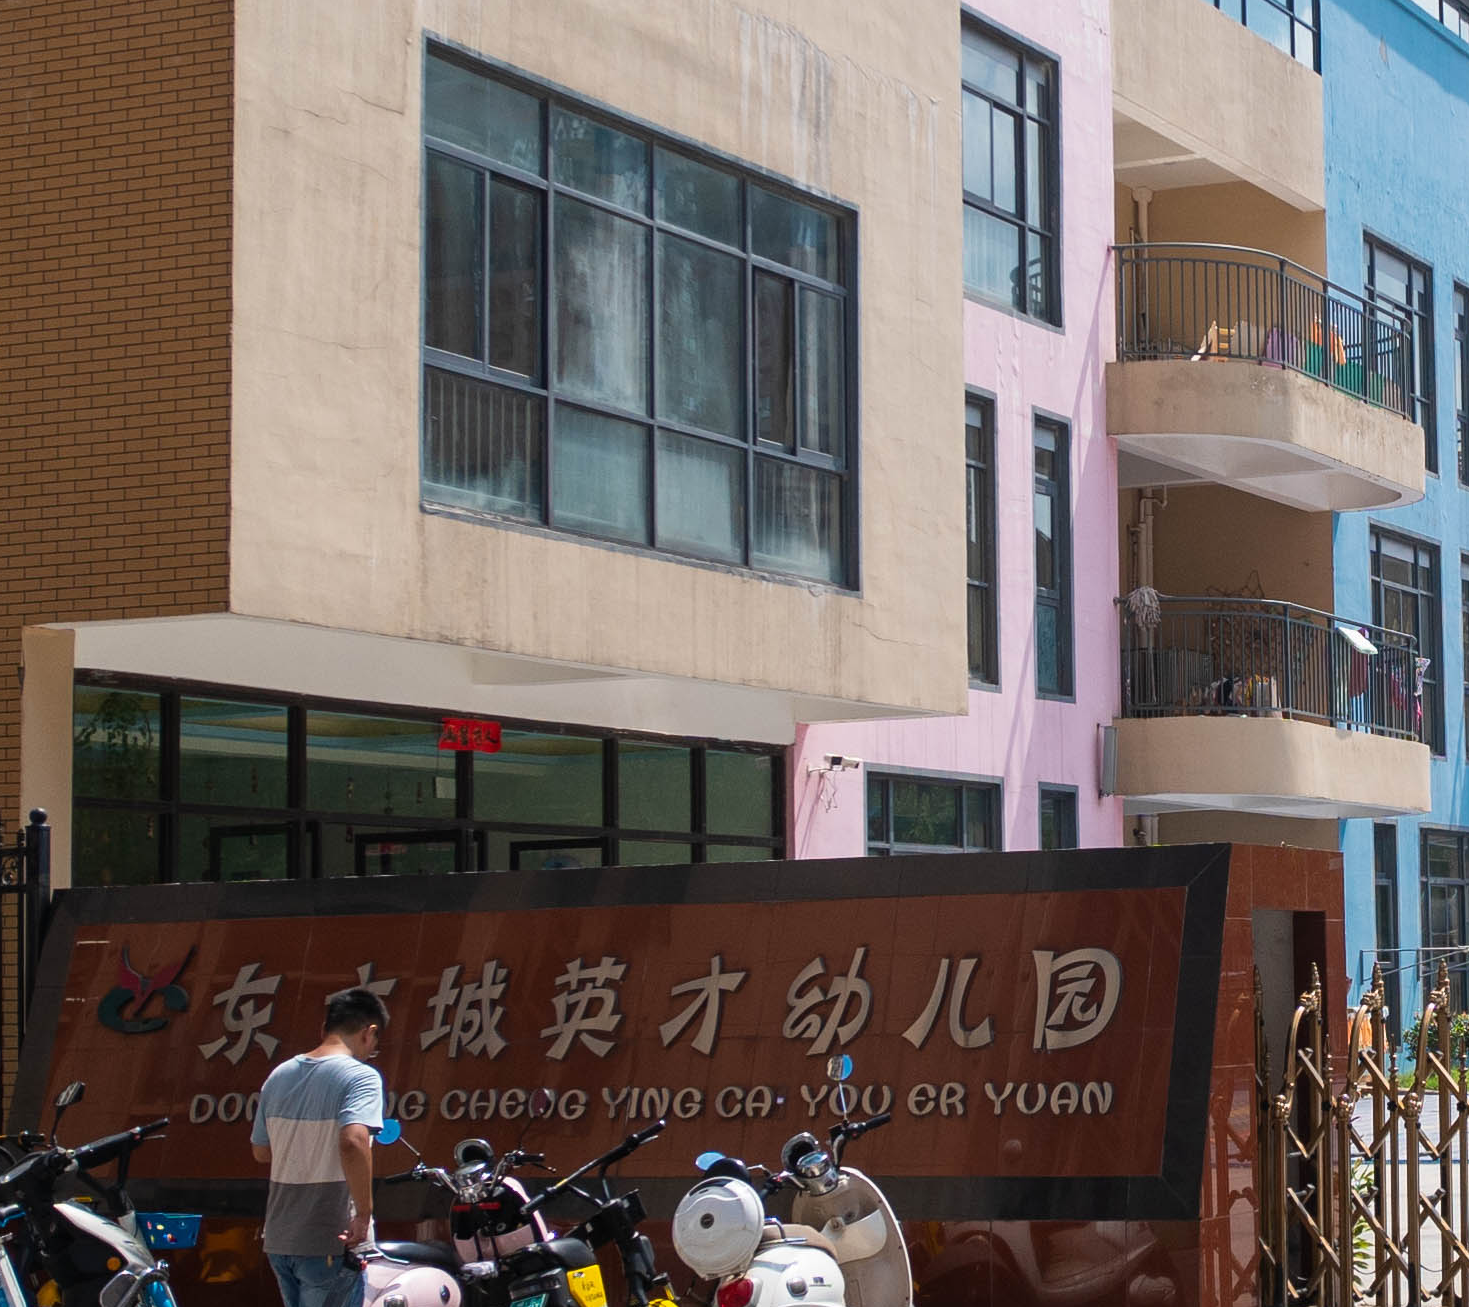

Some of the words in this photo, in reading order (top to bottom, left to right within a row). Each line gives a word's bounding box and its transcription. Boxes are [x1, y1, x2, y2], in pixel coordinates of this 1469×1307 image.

[602, 1087, 702, 1119] YING
[800, 1084, 891, 1116] YOU
[907, 1082, 965, 1115] ER
[984, 1081, 1113, 1115] YUAN
